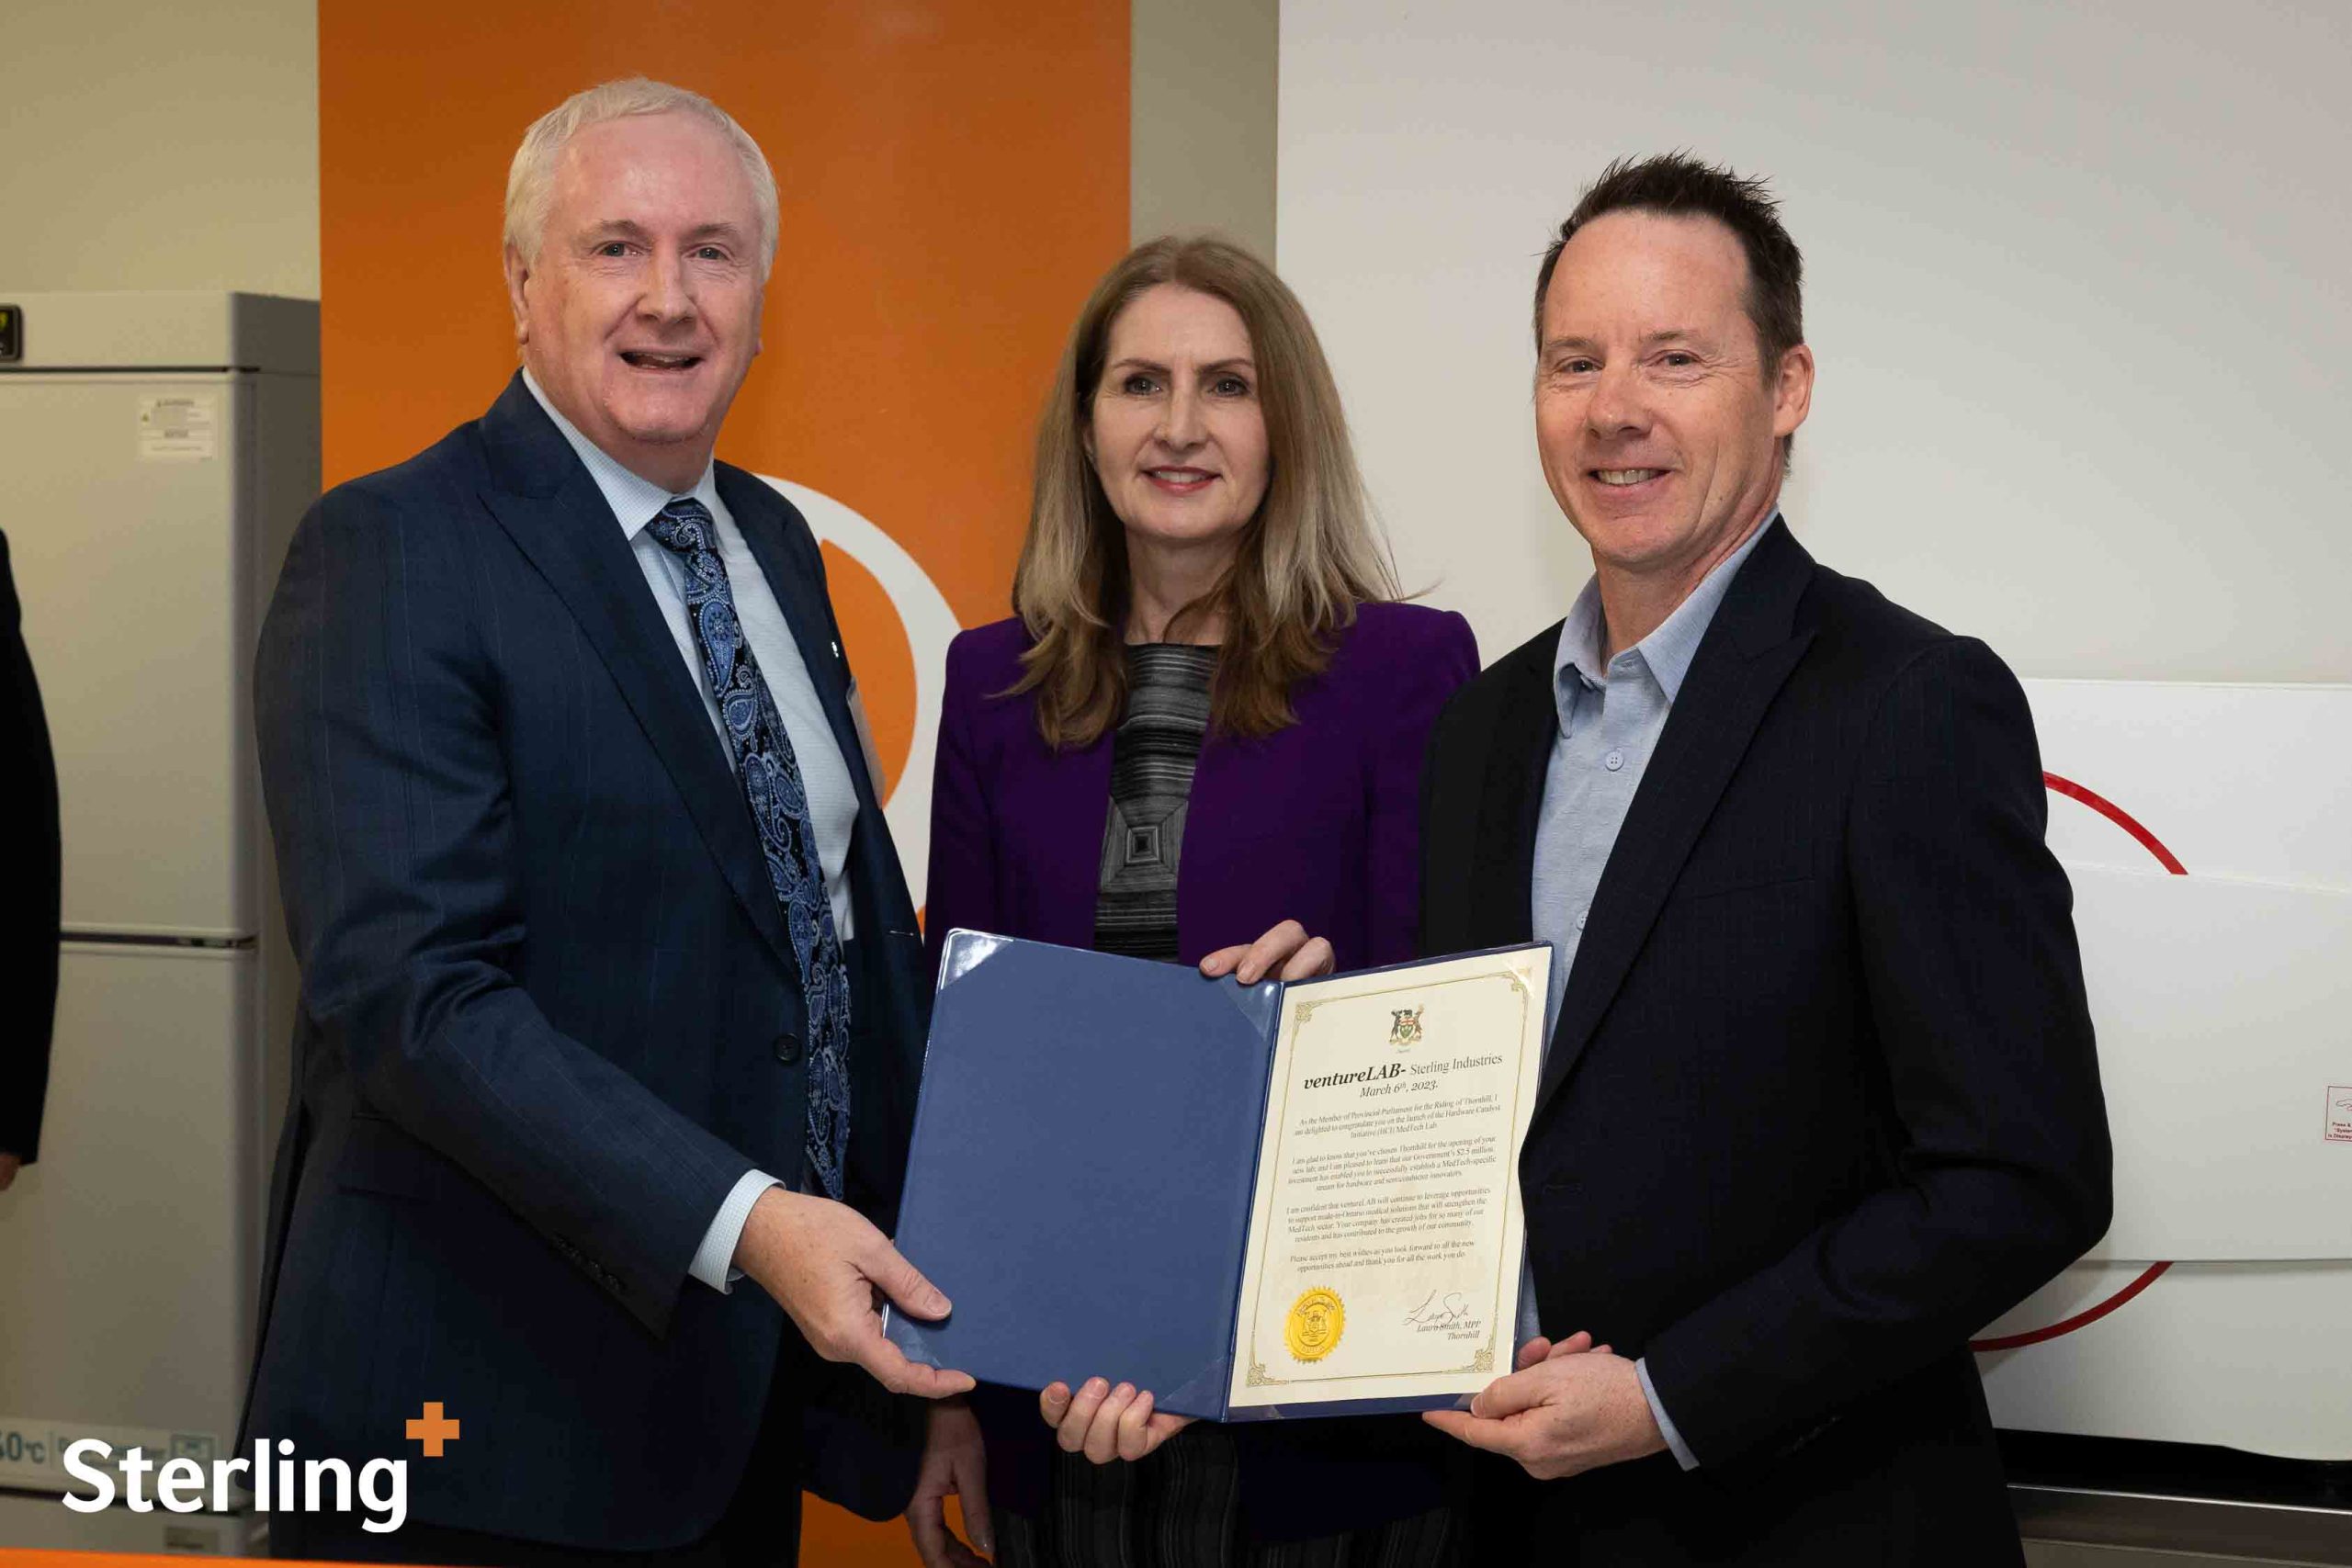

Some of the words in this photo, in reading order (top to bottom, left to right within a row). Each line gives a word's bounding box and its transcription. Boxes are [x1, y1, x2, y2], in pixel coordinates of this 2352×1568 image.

[1304, 1062, 1406, 1089] ventureLAB-
[1409, 1062, 1450, 1077] Sterling
[1453, 1053, 1502, 1070] Industries
[1360, 1086, 1392, 1098] March
[1411, 1080, 1438, 1091] 2023.
[1304, 1125, 1330, 1135] delighted
[1339, 1120, 1374, 1131] congratulate
[1445, 1108, 1475, 1117] Hardware
[1476, 1105, 1499, 1113] Catalyst
[1318, 1115, 1341, 1123] Member
[1351, 1109, 1380, 1120] Provincial
[1382, 1104, 1413, 1115] Parliament
[1434, 1100, 1453, 1109] Riding
[1396, 1124, 1423, 1133] MedTech
[1306, 1156, 1318, 1165] glad
[1356, 1149, 1375, 1159] you've
[1376, 1146, 1396, 1156] chosen
[1399, 1142, 1426, 1152] Thornhill
[1449, 1139, 1472, 1147] opening
[1475, 1135, 1482, 1144] of
[1482, 1135, 1496, 1144] your
[1344, 1159, 1364, 1169] pleased
[1389, 1154, 1400, 1163] that
[1413, 1151, 1454, 1160] Government's
[1471, 1146, 1493, 1155] million
[1288, 1176, 1317, 1184] investment
[1330, 1171, 1352, 1180] enabled
[1374, 1164, 1408, 1175] successfully
[1409, 1162, 1438, 1171] establish
[1442, 1156, 1497, 1168] MedTech-specific
[1346, 1180, 1372, 1189] hardware
[1300, 1204, 1328, 1213] confident
[1377, 1196, 1389, 1204] will
[1390, 1195, 1415, 1203] continue
[1424, 1191, 1449, 1200] leverage
[1451, 1188, 1490, 1198] opportunities
[1419, 1202, 1430, 1211] that
[1444, 1200, 1476, 1208] strengthen
[1352, 1219, 1378, 1228] company
[1465, 1208, 1473, 1216] of
[1344, 1228, 1377, 1237] contributed
[1396, 1224, 1417, 1234] growth
[1309, 1254, 1328, 1263] accept
[1381, 1247, 1393, 1256] you
[1409, 1242, 1434, 1251] forward
[1452, 1240, 1460, 1248] the
[1297, 1264, 1334, 1273] opportunities
[1365, 1258, 1381, 1266] thank
[1427, 1252, 1442, 1260] work
[1443, 1252, 1454, 1260] you
[1447, 1330, 1480, 1341] Thornhill
[1464, 1320, 1481, 1330] MPP
